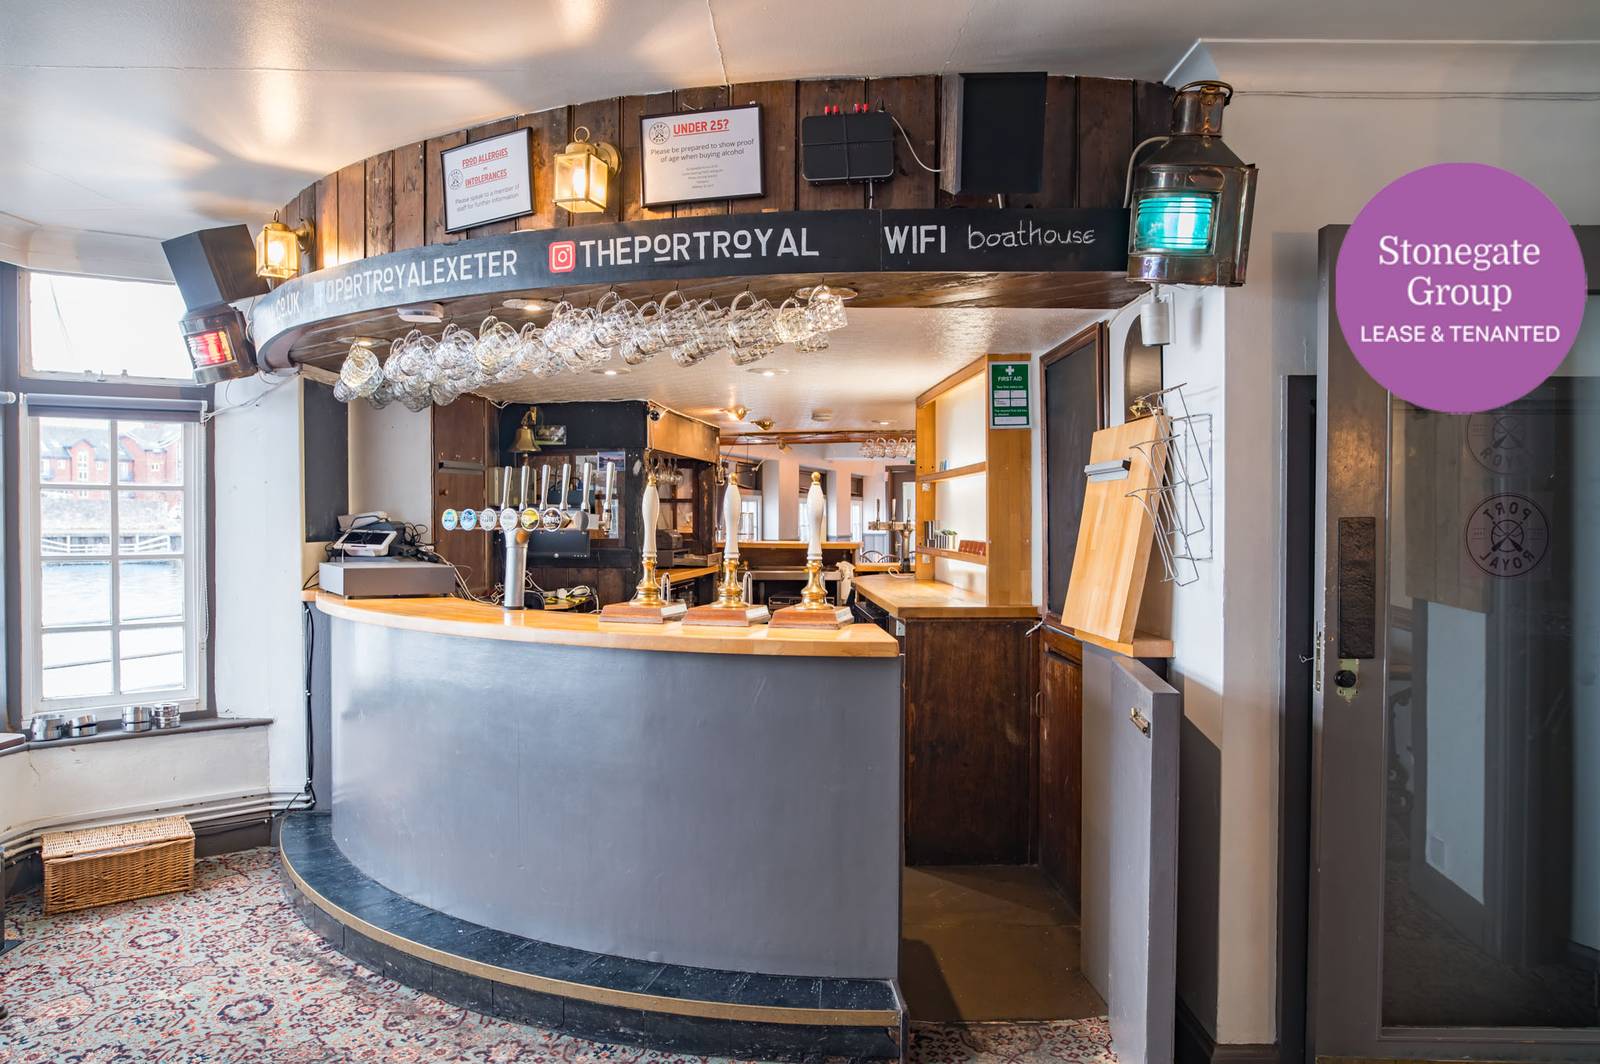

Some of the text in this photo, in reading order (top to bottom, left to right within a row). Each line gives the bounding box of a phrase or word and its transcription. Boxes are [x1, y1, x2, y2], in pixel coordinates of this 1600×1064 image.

[673, 119, 729, 135] UNDER 25?
[681, 143, 710, 154] prepared
[737, 138, 754, 146] proof
[478, 148, 508, 163] ALLERGIES
[681, 153, 698, 161] when
[699, 150, 721, 159] buying
[721, 148, 744, 156] alcohol
[465, 169, 508, 187] INTOLERANCES
[884, 219, 1096, 254] WIFI boathouse
[579, 227, 820, 268] THEPORTROYAL
